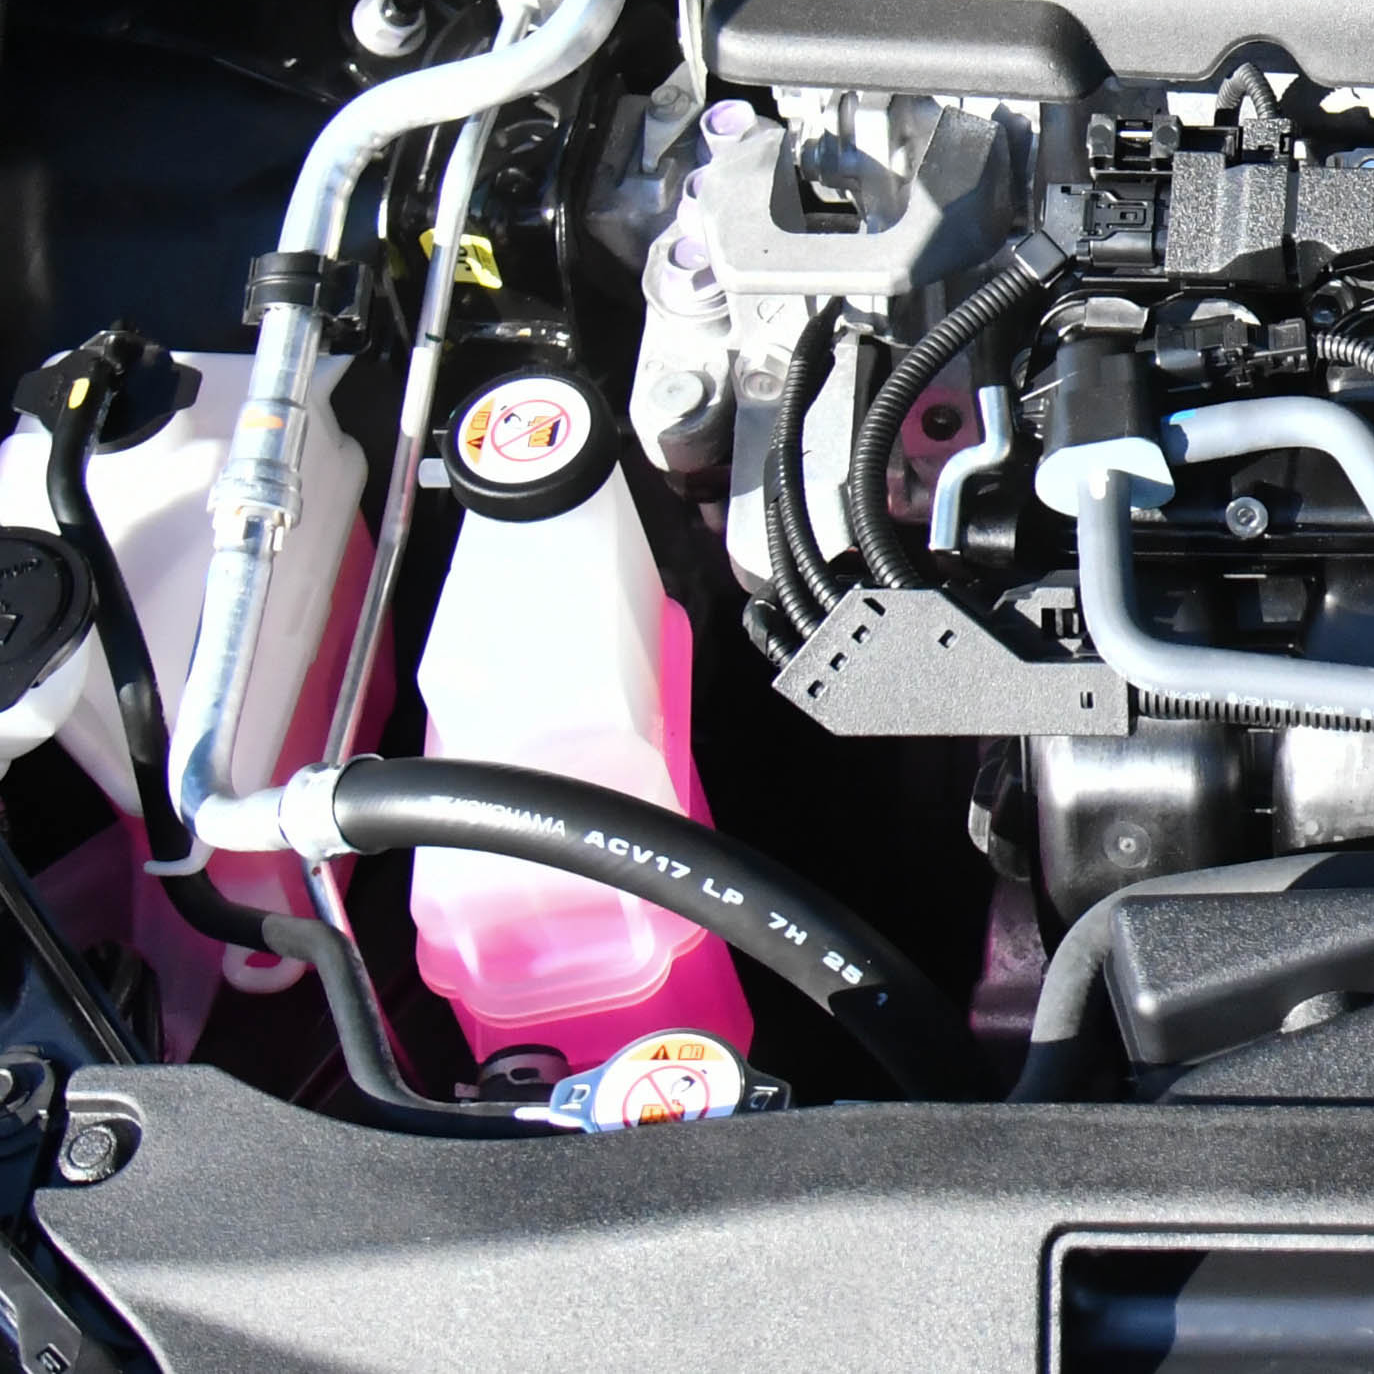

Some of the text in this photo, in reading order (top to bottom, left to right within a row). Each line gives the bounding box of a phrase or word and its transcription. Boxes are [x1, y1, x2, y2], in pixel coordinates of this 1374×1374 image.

[583, 830, 691, 879] ACV17
[702, 877, 744, 905] LP
[768, 911, 807, 946] 7H
[822, 950, 863, 985] 25
